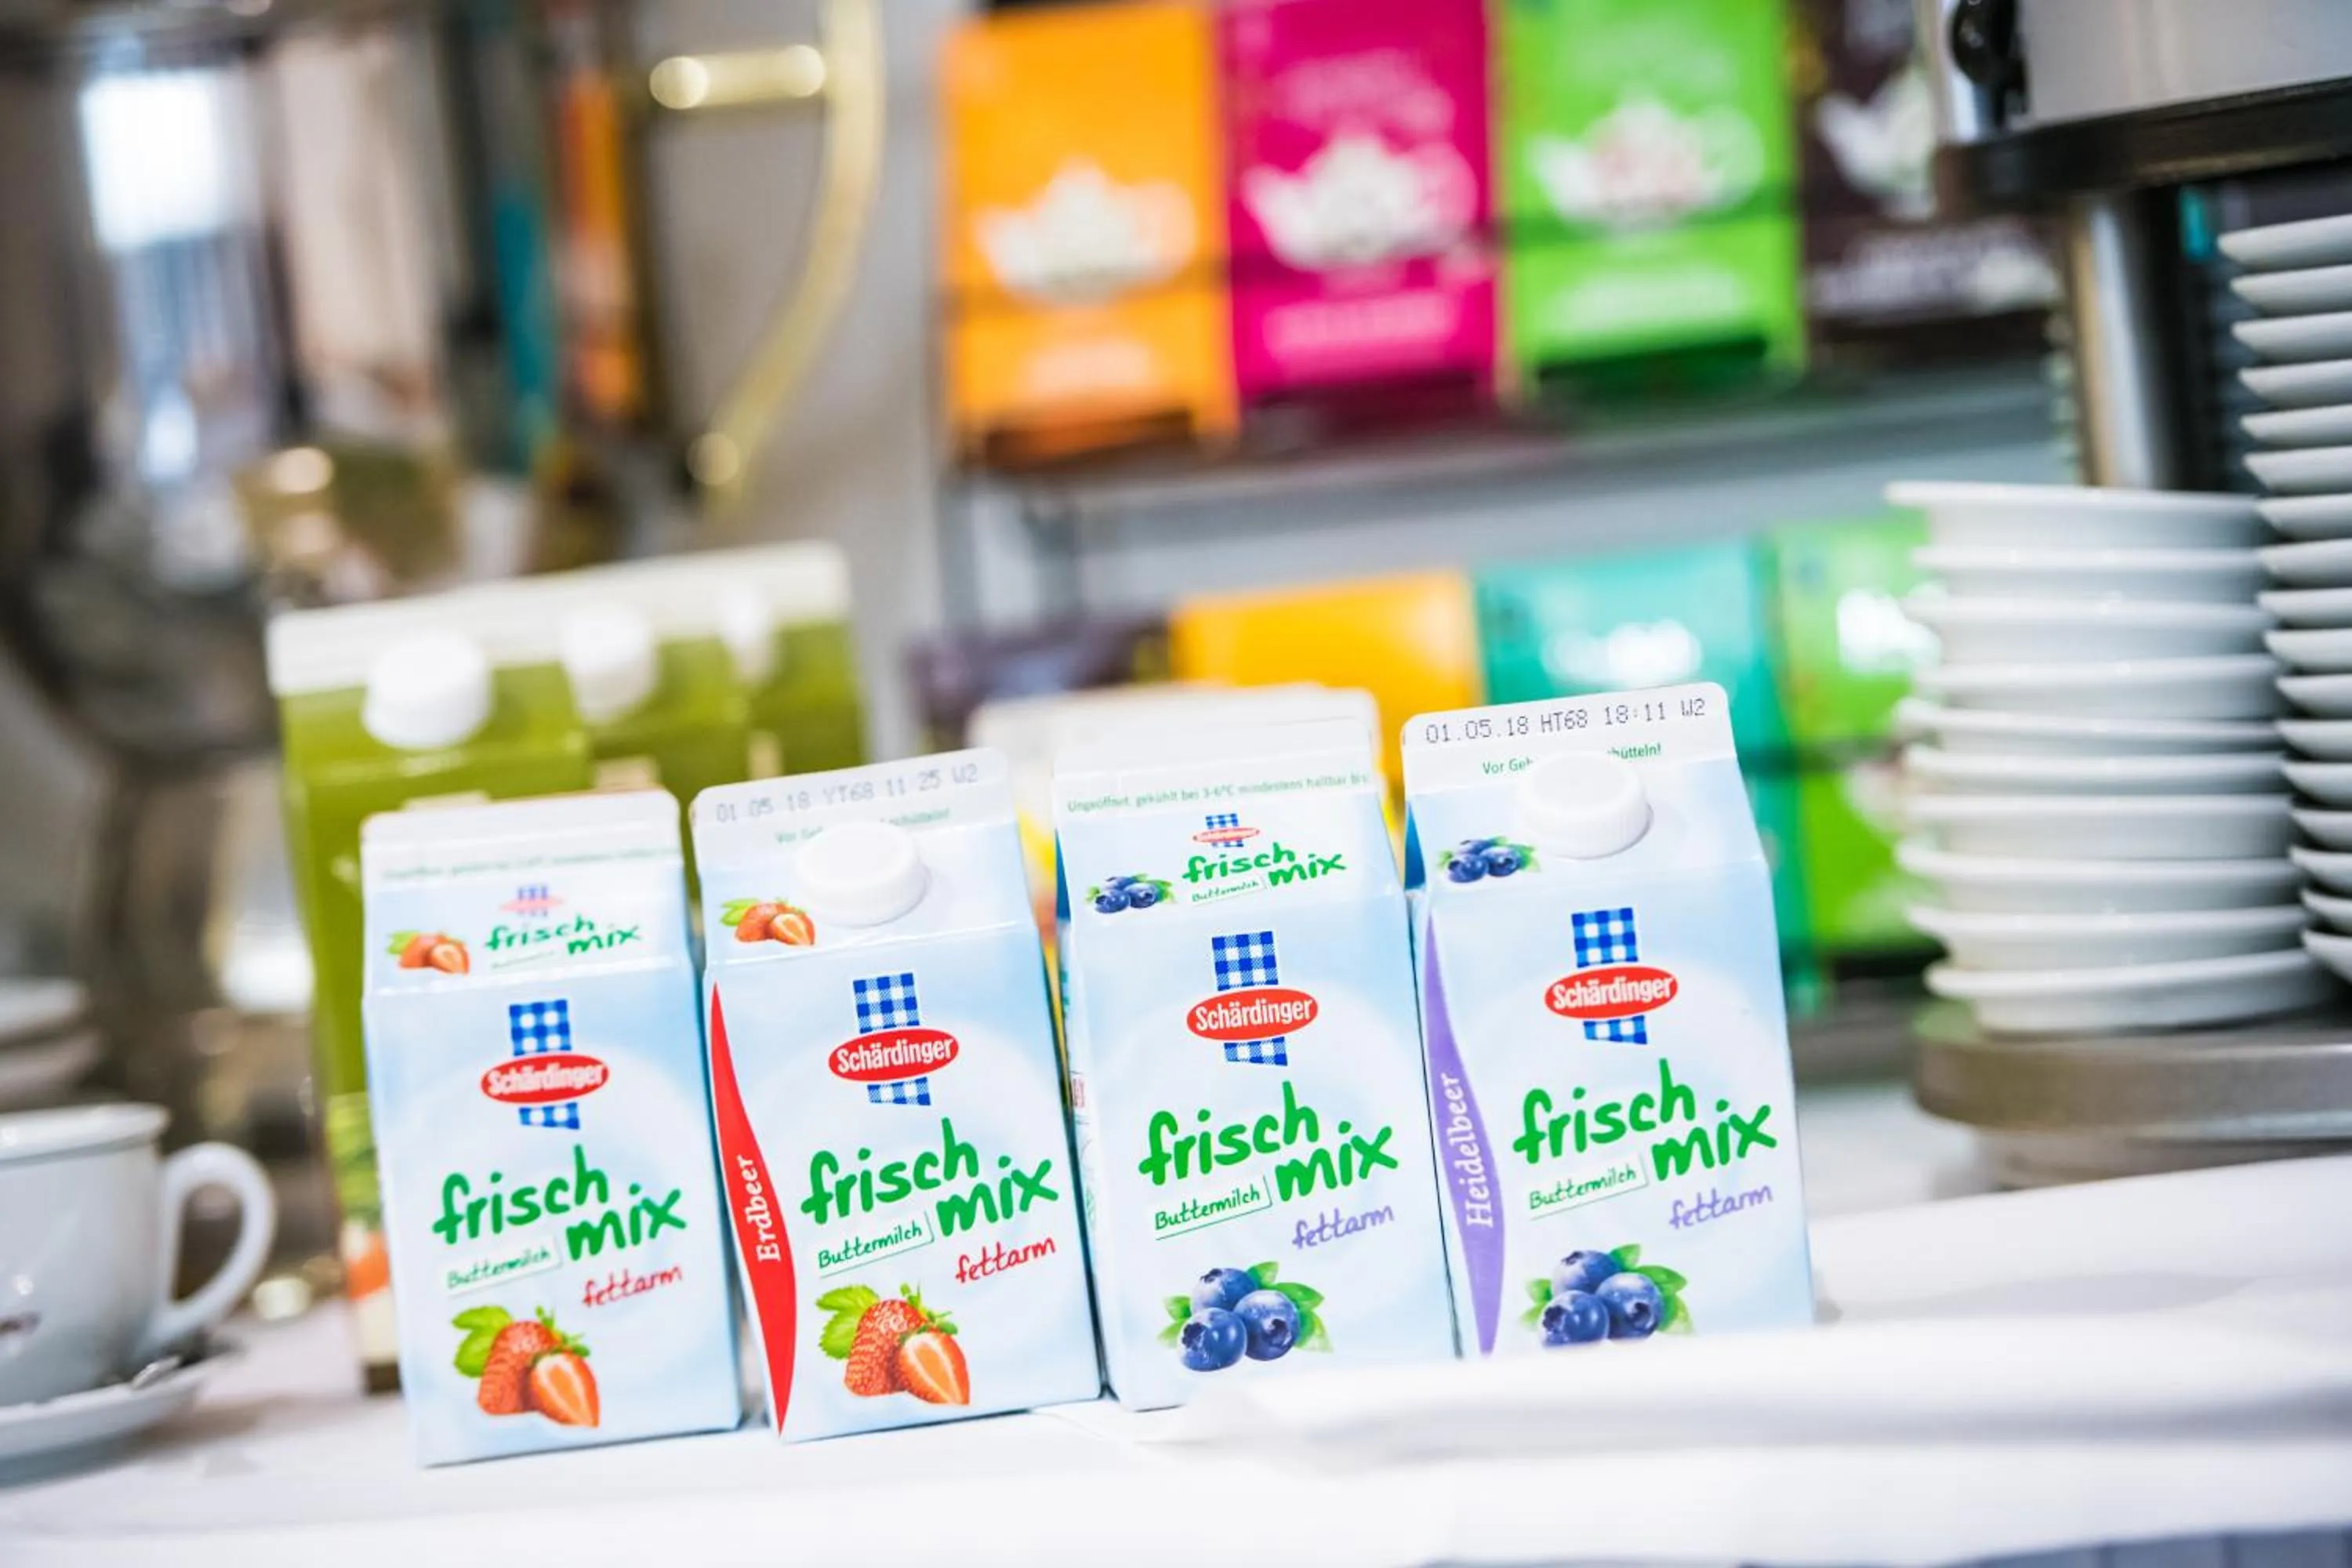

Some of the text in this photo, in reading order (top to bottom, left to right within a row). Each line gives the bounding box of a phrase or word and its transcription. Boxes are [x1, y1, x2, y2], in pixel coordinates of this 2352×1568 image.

[1426, 697, 1706, 743] 01.05.18 HT68 18:11 W2
[1482, 760, 1505, 775] Vor
[1181, 841, 1347, 887] frisch mix
[485, 913, 643, 956] frisch mix
[1194, 997, 1314, 1032] Schärdinger
[1552, 975, 1673, 1010] Schärdinger
[837, 1036, 954, 1074] Schärdinger
[487, 1062, 605, 1096] Schärdinger
[1138, 1080, 1399, 1202] frisch mix
[1512, 1058, 1777, 1181] frisch mix
[1440, 1073, 1494, 1229] Heidelbeer
[800, 1117, 1059, 1237] frisch mix
[1529, 1164, 1637, 1210] Buttermilch
[432, 1144, 687, 1261] frisch mix
[737, 1155, 782, 1262] Erdbeer
[1154, 1184, 1261, 1232] Buttermilch
[1668, 1185, 1773, 1230] fettarm
[818, 1220, 923, 1269] Buttermilch
[1291, 1205, 1396, 1250] fettarm
[446, 1247, 551, 1290] Buttermilch
[955, 1237, 1056, 1283] fettarm
[582, 1266, 682, 1308] fettarm
